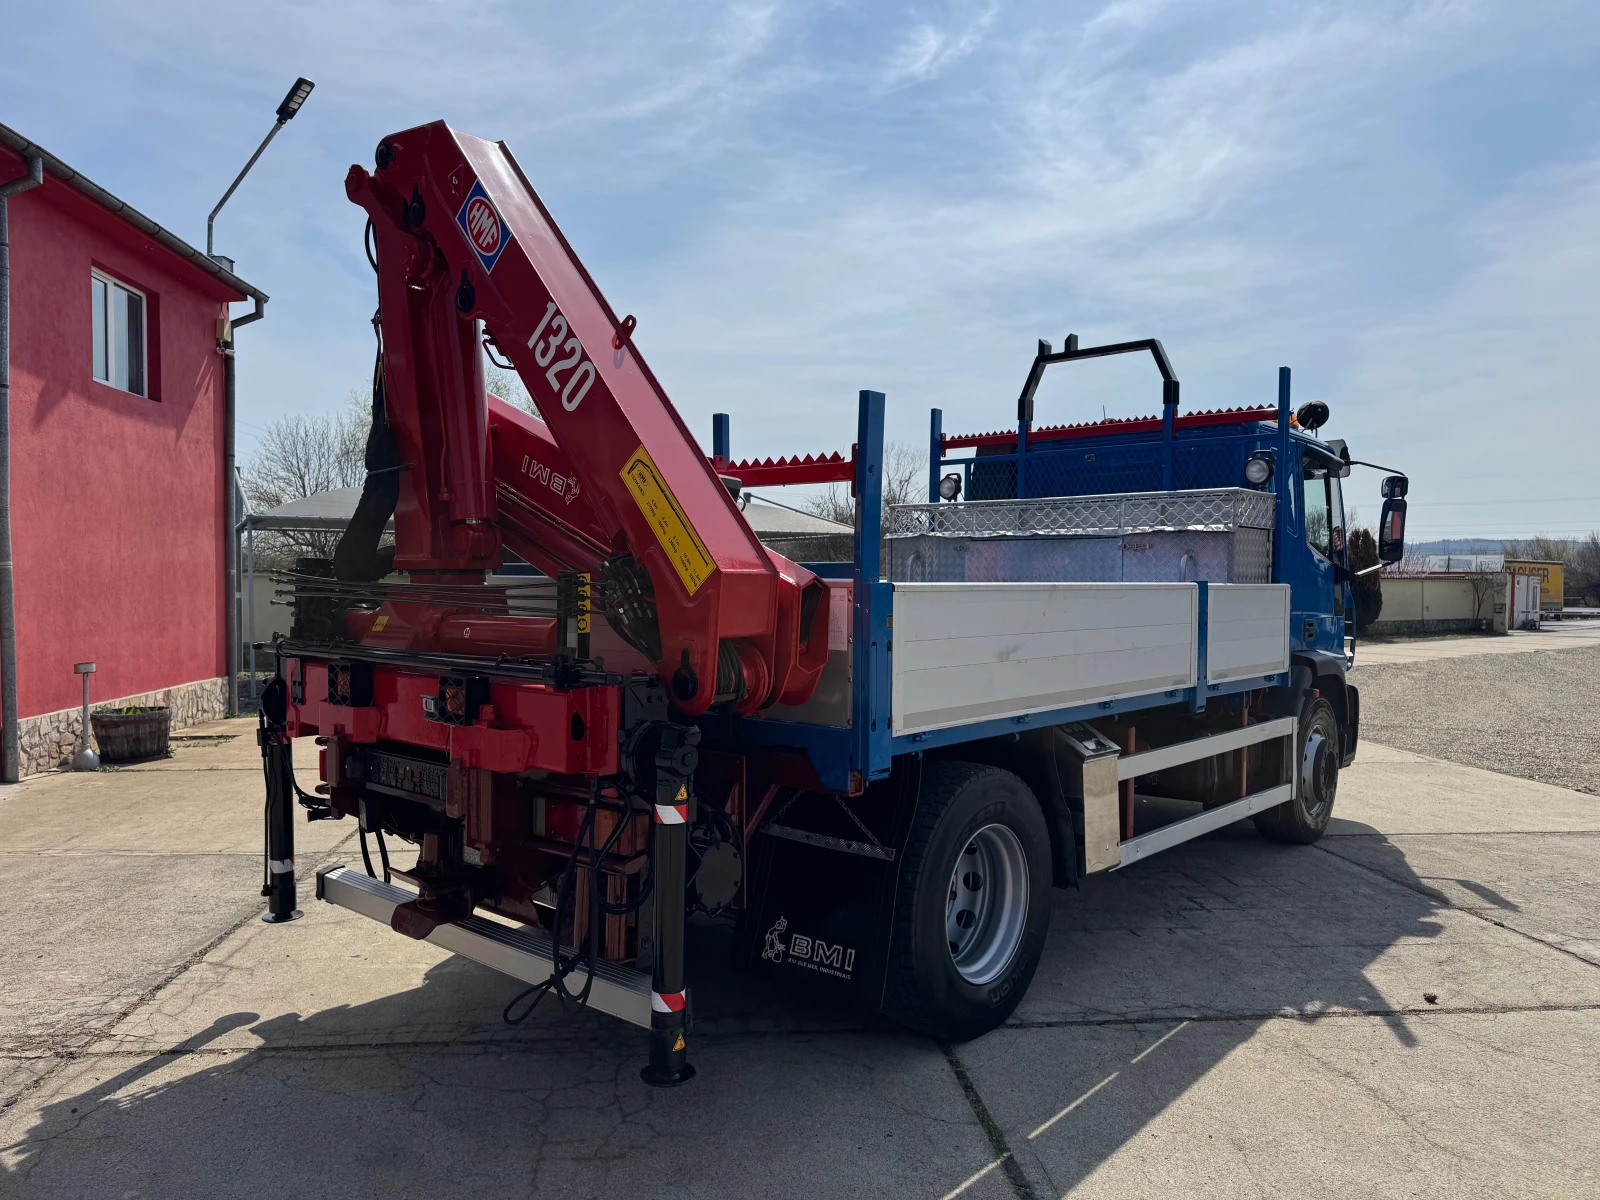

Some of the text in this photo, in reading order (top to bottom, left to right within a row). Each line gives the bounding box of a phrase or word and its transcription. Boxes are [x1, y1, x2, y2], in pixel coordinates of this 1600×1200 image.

[469, 202, 498, 248] HMF
[527, 301, 596, 412] 1320
[521, 455, 568, 497] BMI
[789, 933, 855, 971] BMI
